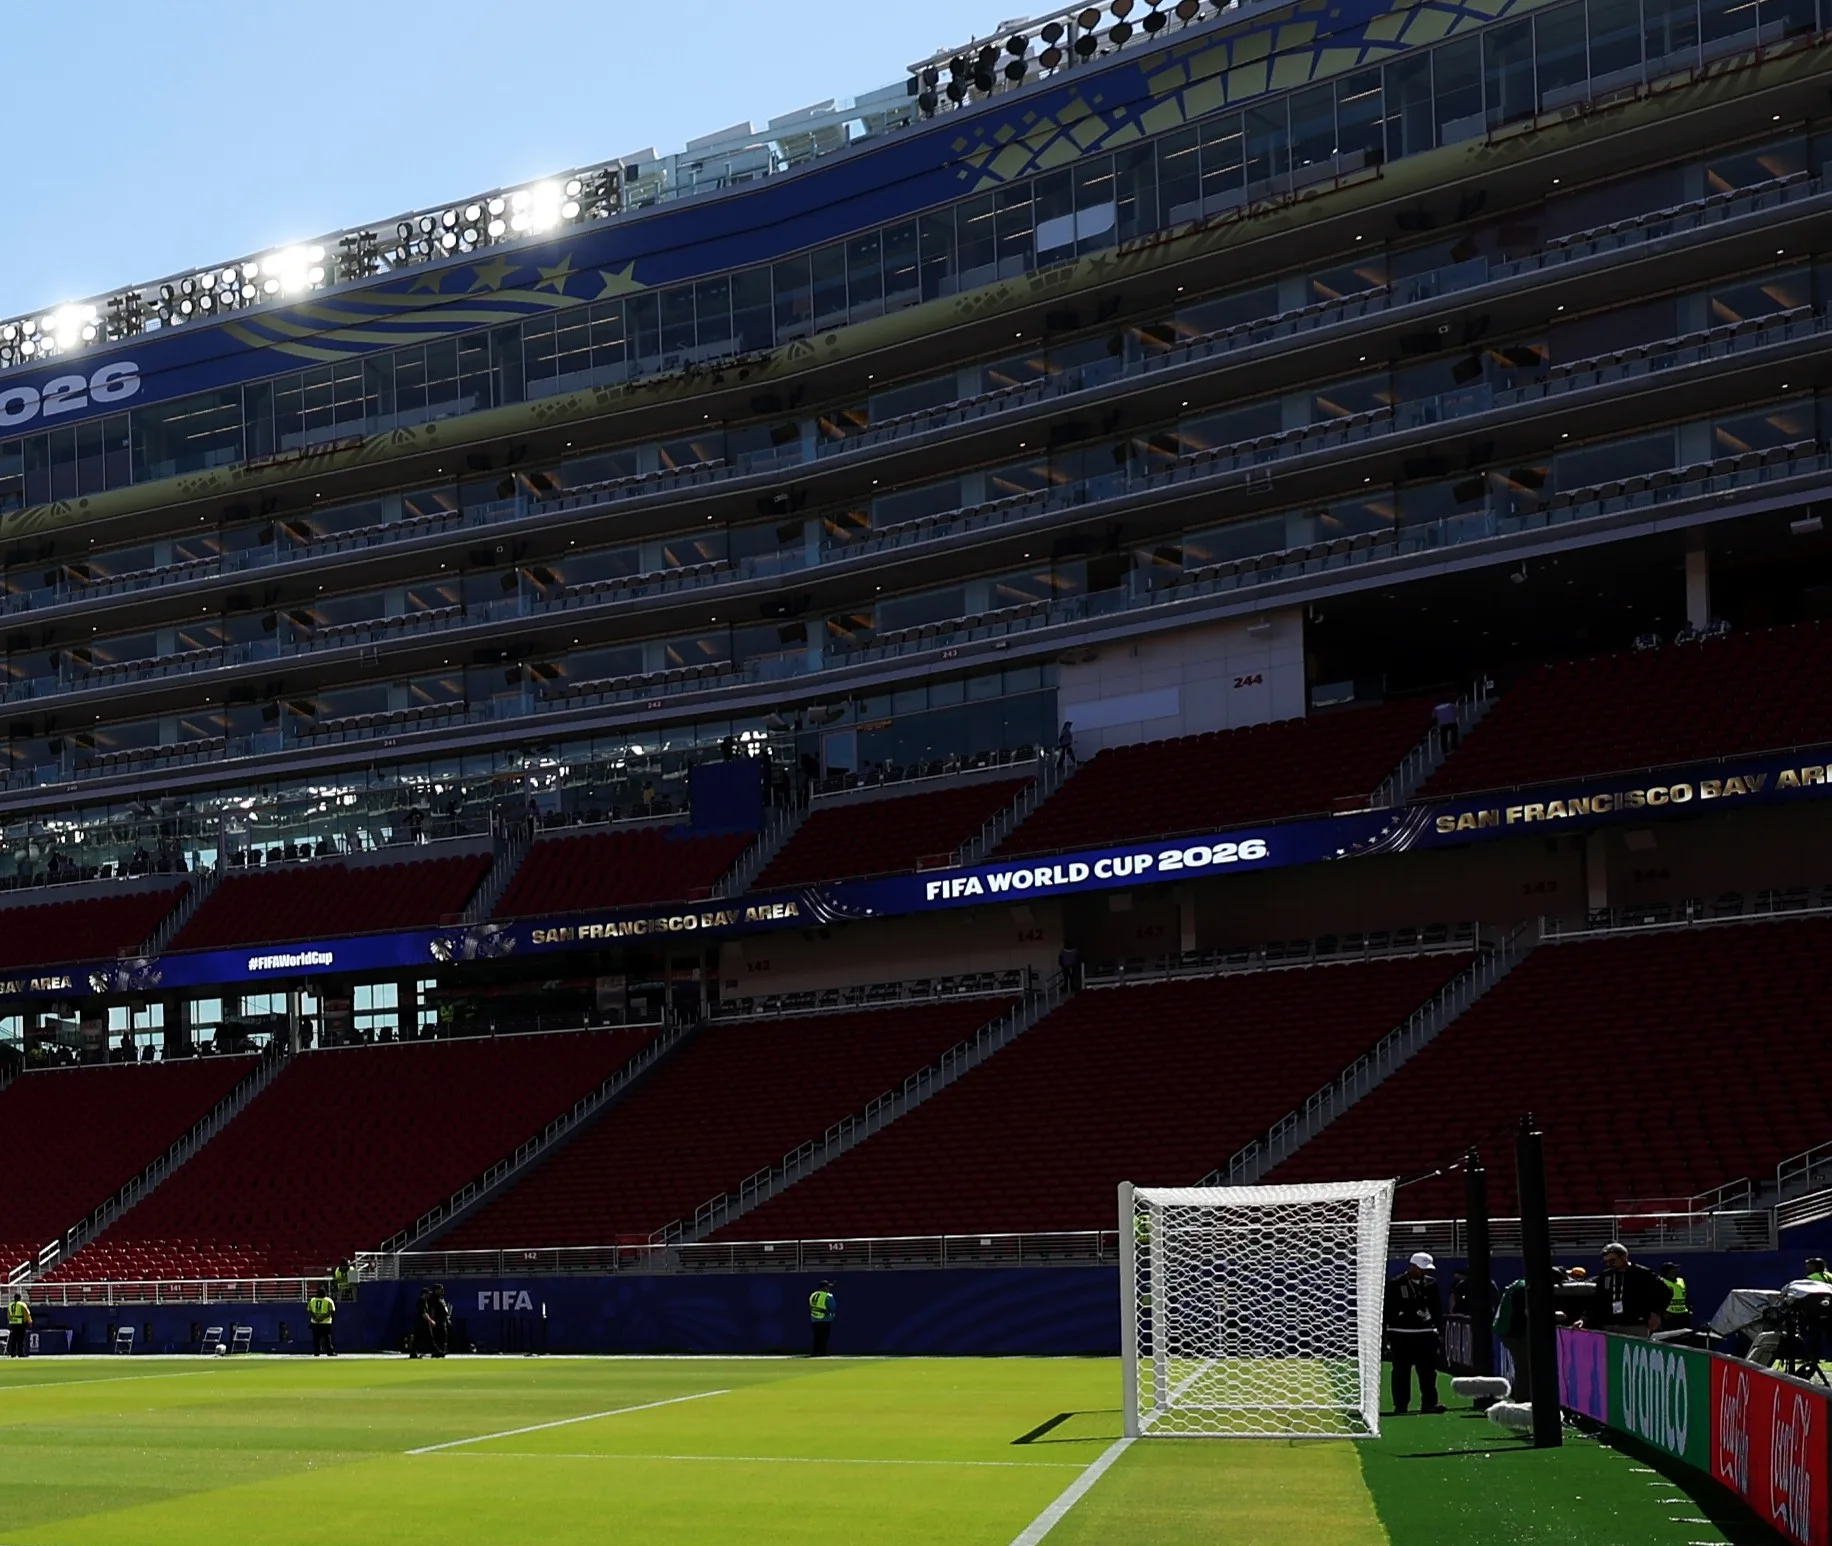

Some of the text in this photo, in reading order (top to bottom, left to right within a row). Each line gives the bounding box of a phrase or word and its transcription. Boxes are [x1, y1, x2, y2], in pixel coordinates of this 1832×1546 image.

[1234, 674, 1264, 688] 244
[1436, 809, 1499, 834] SAN
[1505, 783, 1693, 824] FRANCISCO
[1699, 773, 1767, 800] BAY
[926, 839, 1267, 900] FIFA WORLD CUP 2026
[532, 901, 800, 944] SAN FRANCISCO BAY AREA
[29, 976, 72, 992] AREA
[248, 951, 333, 971] #FIFAWorldCup
[478, 1291, 533, 1310] FIFA
[1622, 1343, 1687, 1456] aramco
[1719, 1365, 1750, 1495] Coca-Cola
[1770, 1384, 1810, 1546] Coca-Cola
